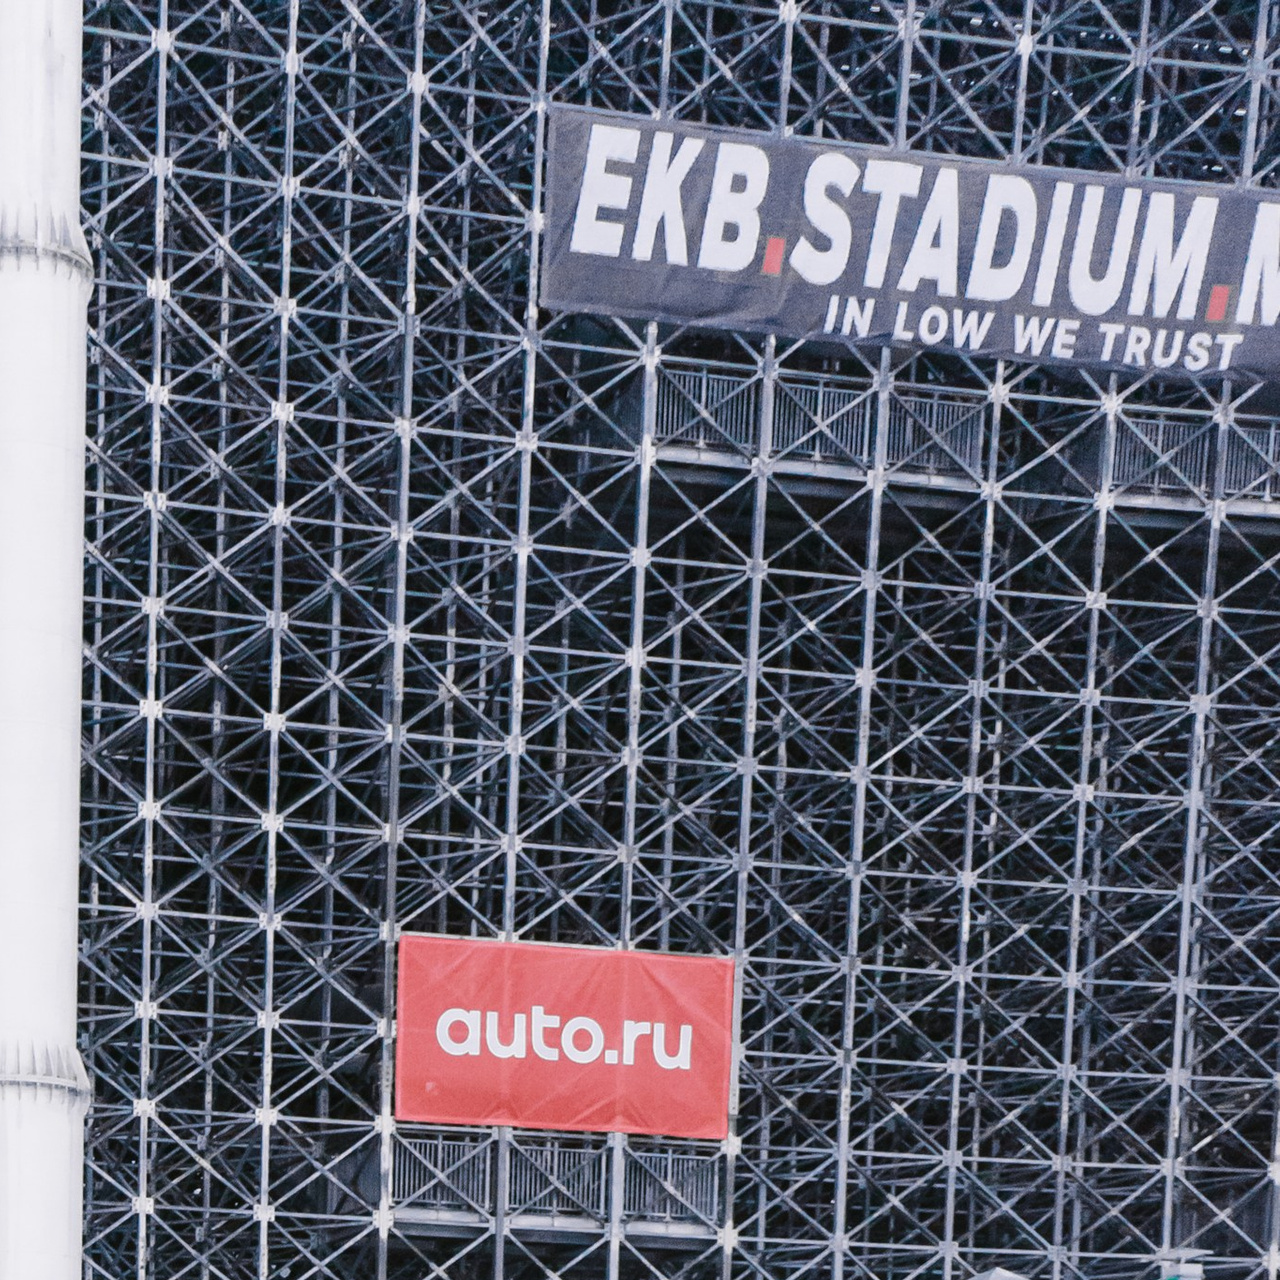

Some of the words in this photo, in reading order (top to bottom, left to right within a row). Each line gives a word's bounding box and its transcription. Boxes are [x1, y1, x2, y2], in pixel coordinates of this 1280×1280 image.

[823, 294, 875, 338] IN
[893, 300, 995, 351] LOW
[1014, 316, 1079, 359] WE
[1099, 328, 1245, 373] TRUST
[435, 1005, 693, 1070] auto.ru
